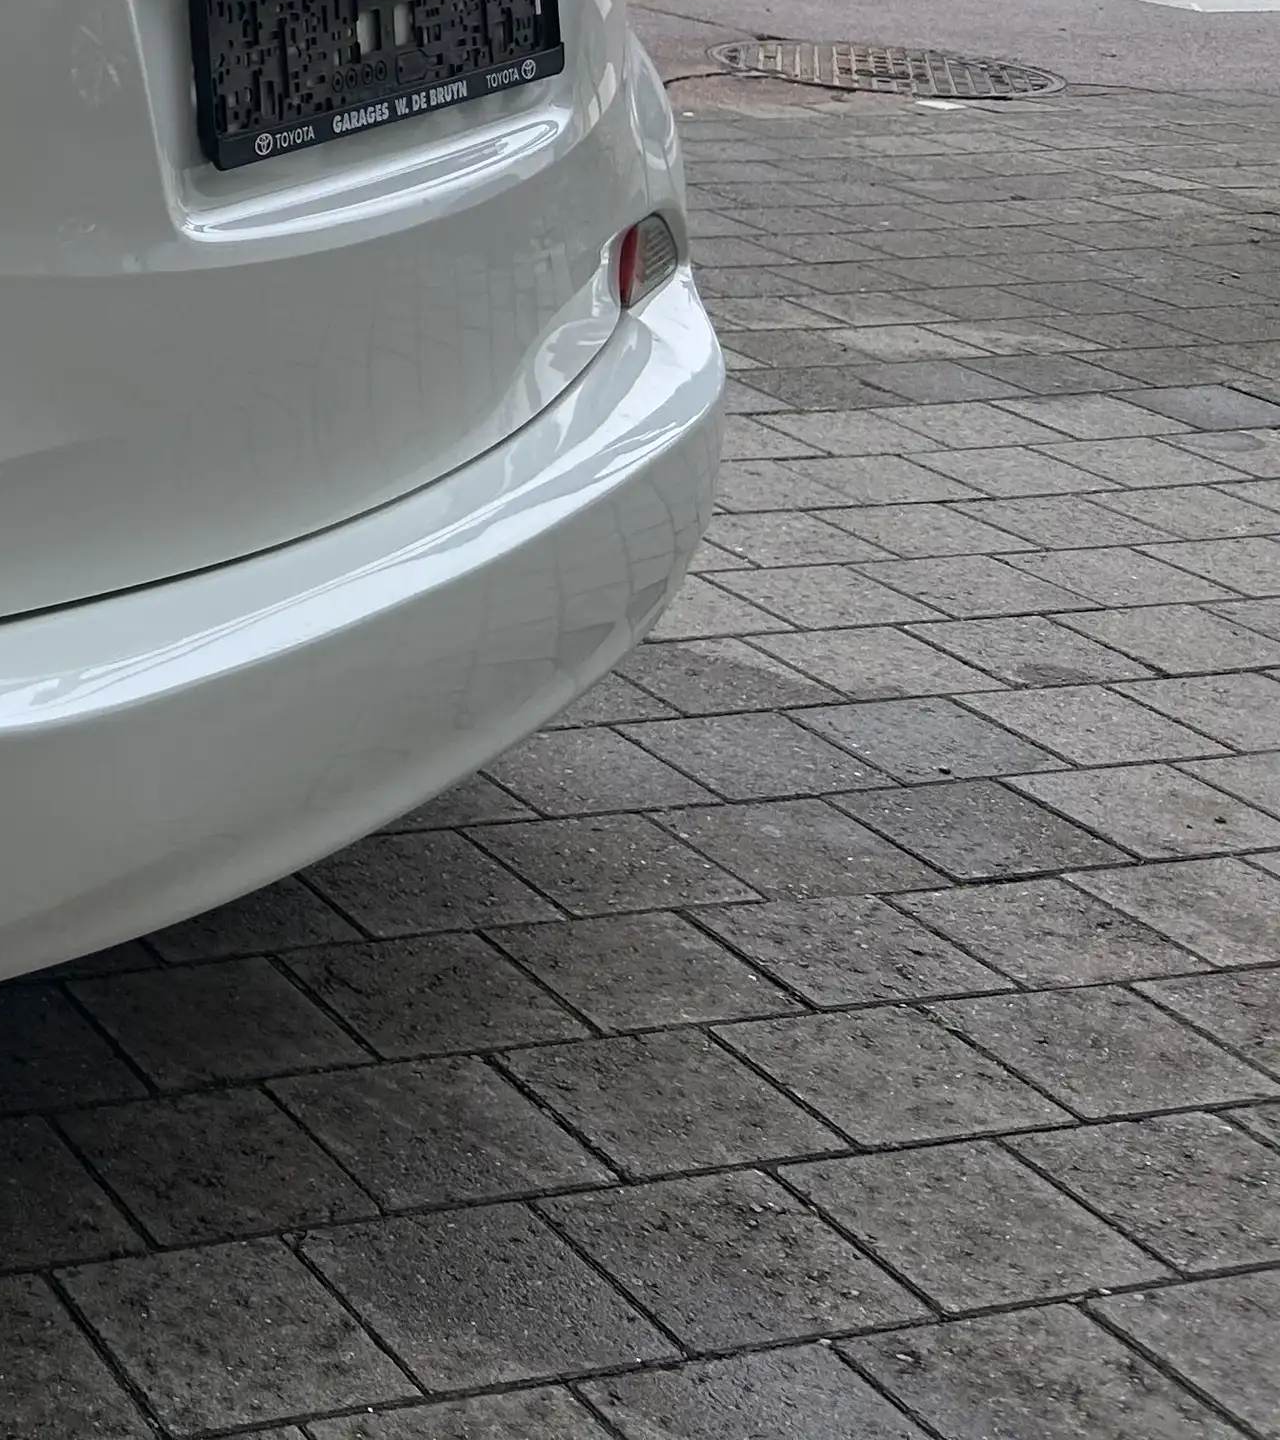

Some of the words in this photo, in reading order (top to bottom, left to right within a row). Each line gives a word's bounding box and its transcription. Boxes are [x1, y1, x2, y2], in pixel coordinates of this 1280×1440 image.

[274, 124, 316, 150] TOYOTA
[332, 101, 390, 134] GARAGES
[394, 96, 410, 116] W.
[411, 91, 428, 111] DE
[429, 80, 469, 107] BRUYN
[485, 70, 521, 93] TOYOTA
